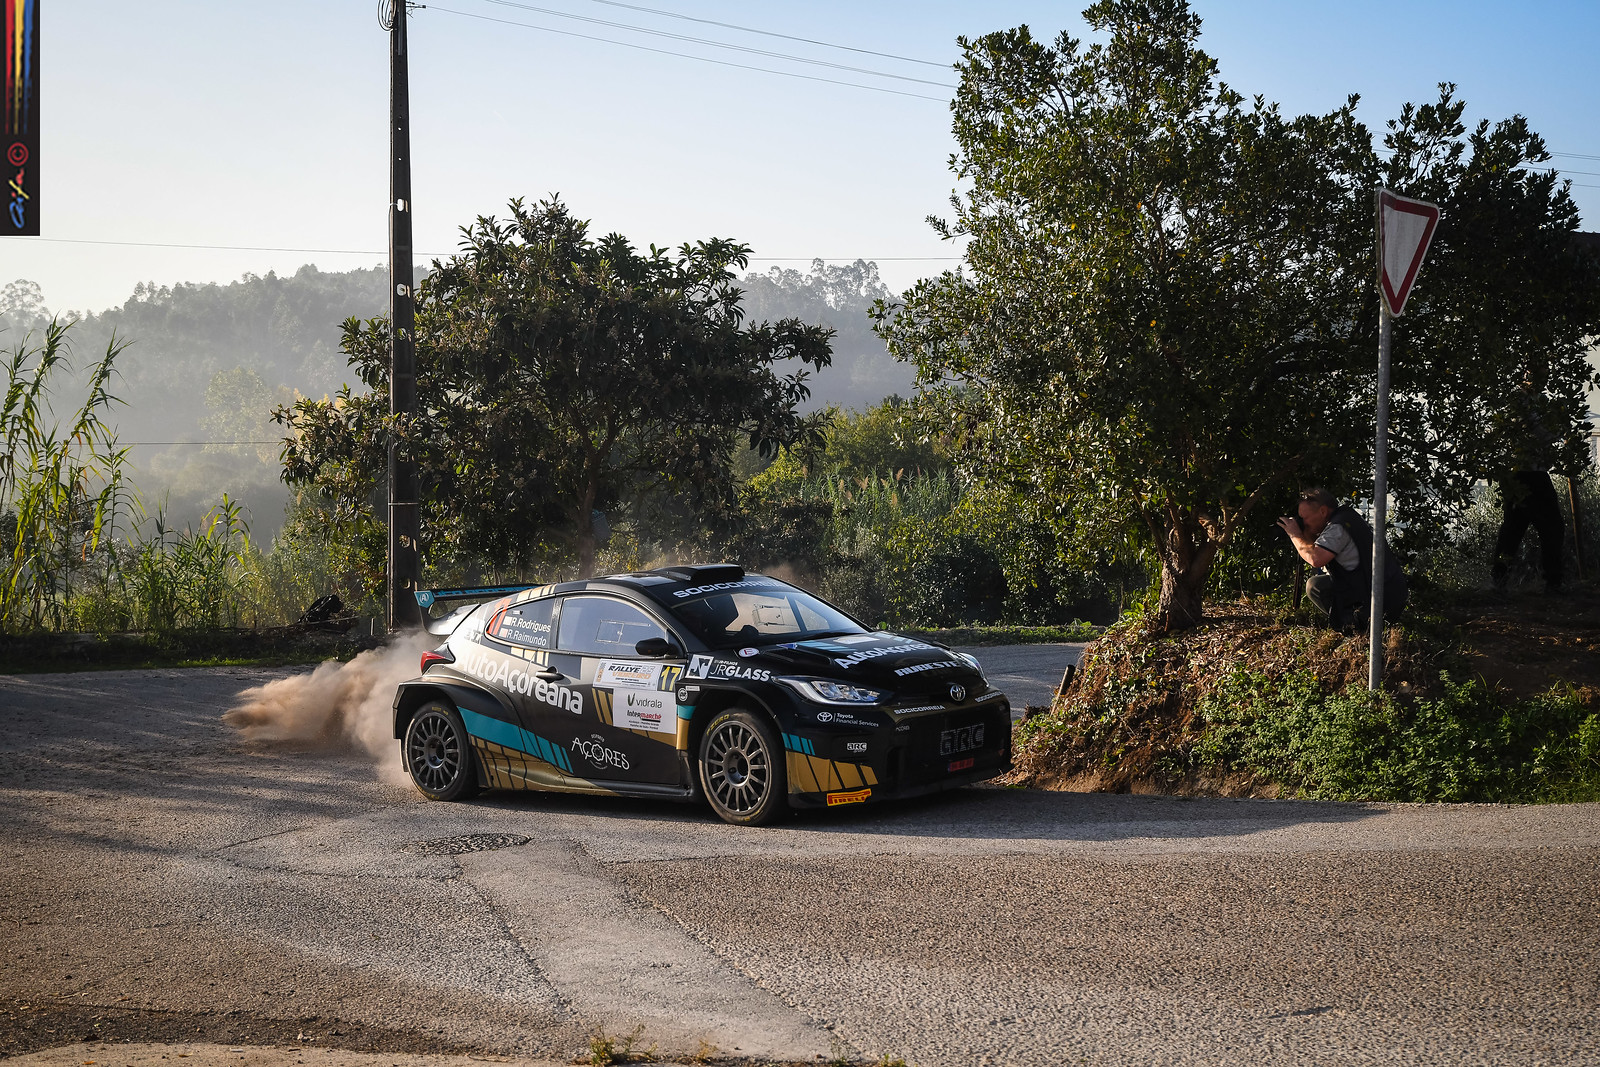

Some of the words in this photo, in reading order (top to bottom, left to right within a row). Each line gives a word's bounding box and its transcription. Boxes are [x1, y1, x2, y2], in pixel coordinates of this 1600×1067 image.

[608, 665, 641, 673] RALLYE
[660, 666, 681, 691] 17
[636, 699, 663, 709] vidrala
[894, 705, 946, 715] SOCICORREIA
[571, 737, 630, 770] AÇORES
